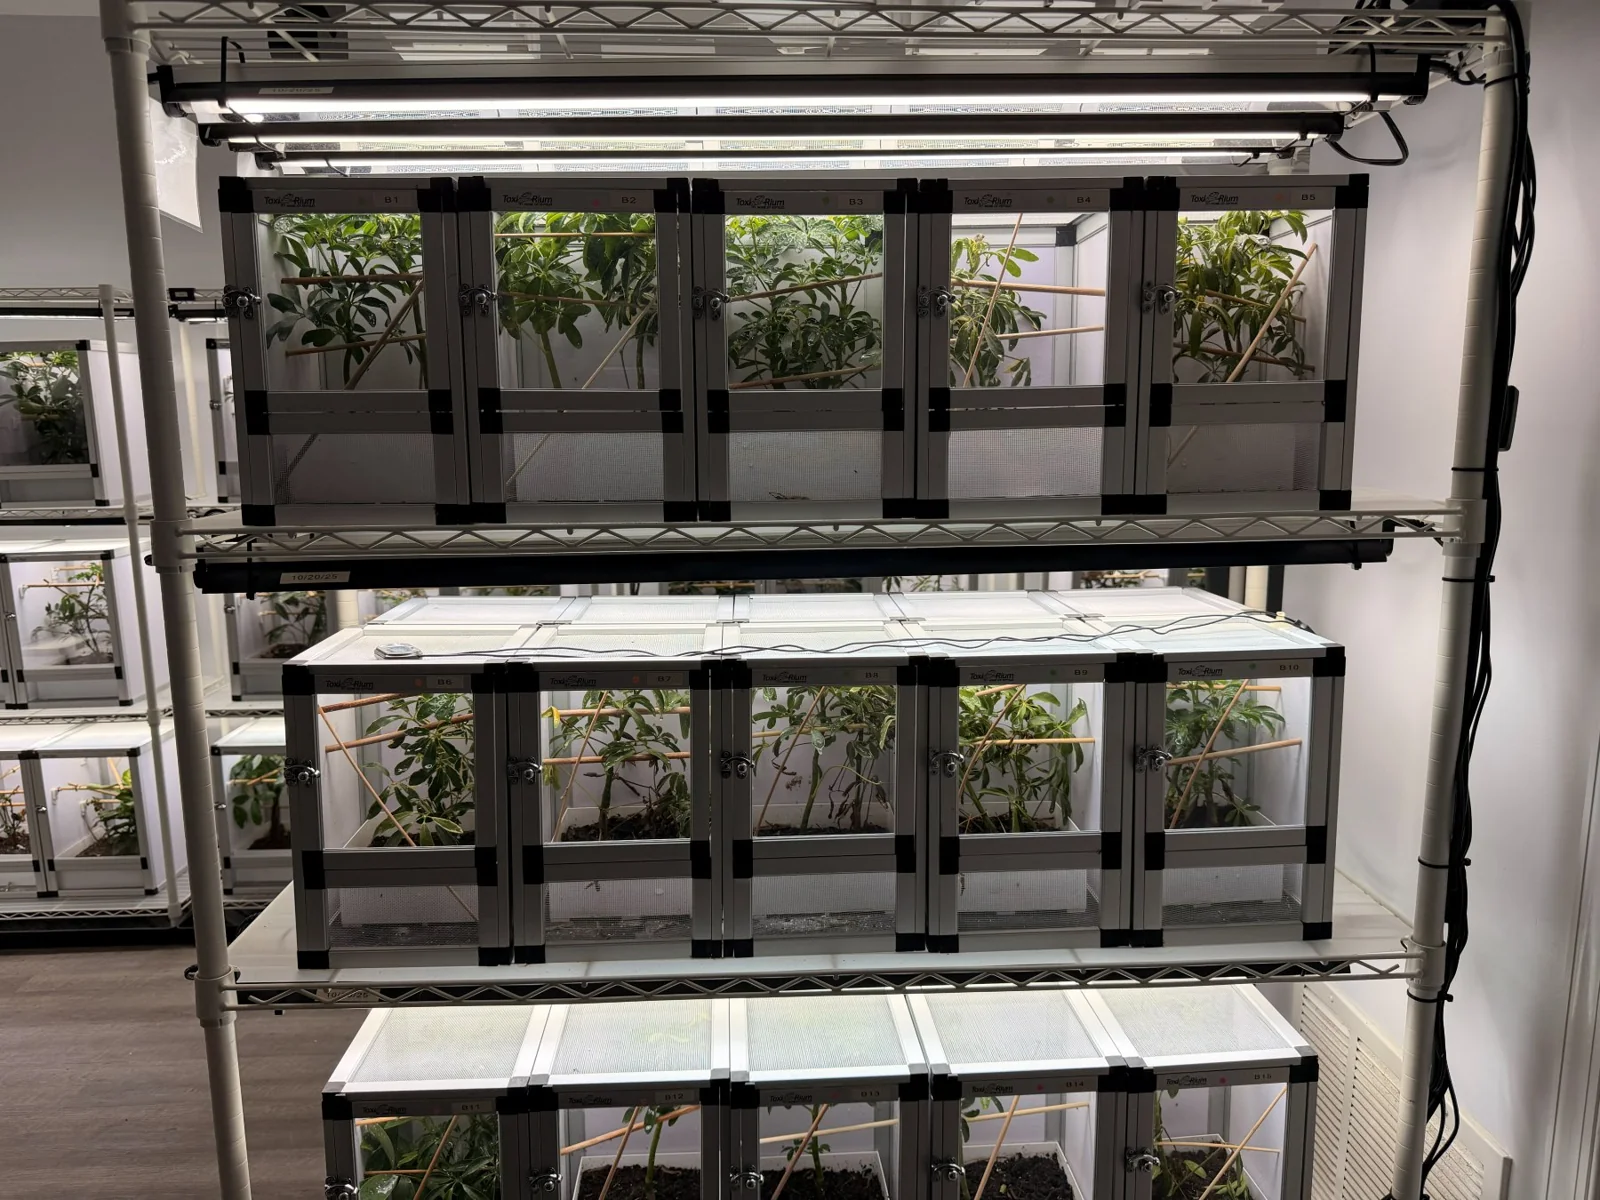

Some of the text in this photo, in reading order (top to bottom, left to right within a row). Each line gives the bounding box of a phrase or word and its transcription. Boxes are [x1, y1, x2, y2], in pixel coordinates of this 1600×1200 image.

[384, 196, 398, 204] B1
[621, 196, 636, 204] B2
[849, 198, 863, 206] B3
[291, 573, 338, 582] 10/20/25
